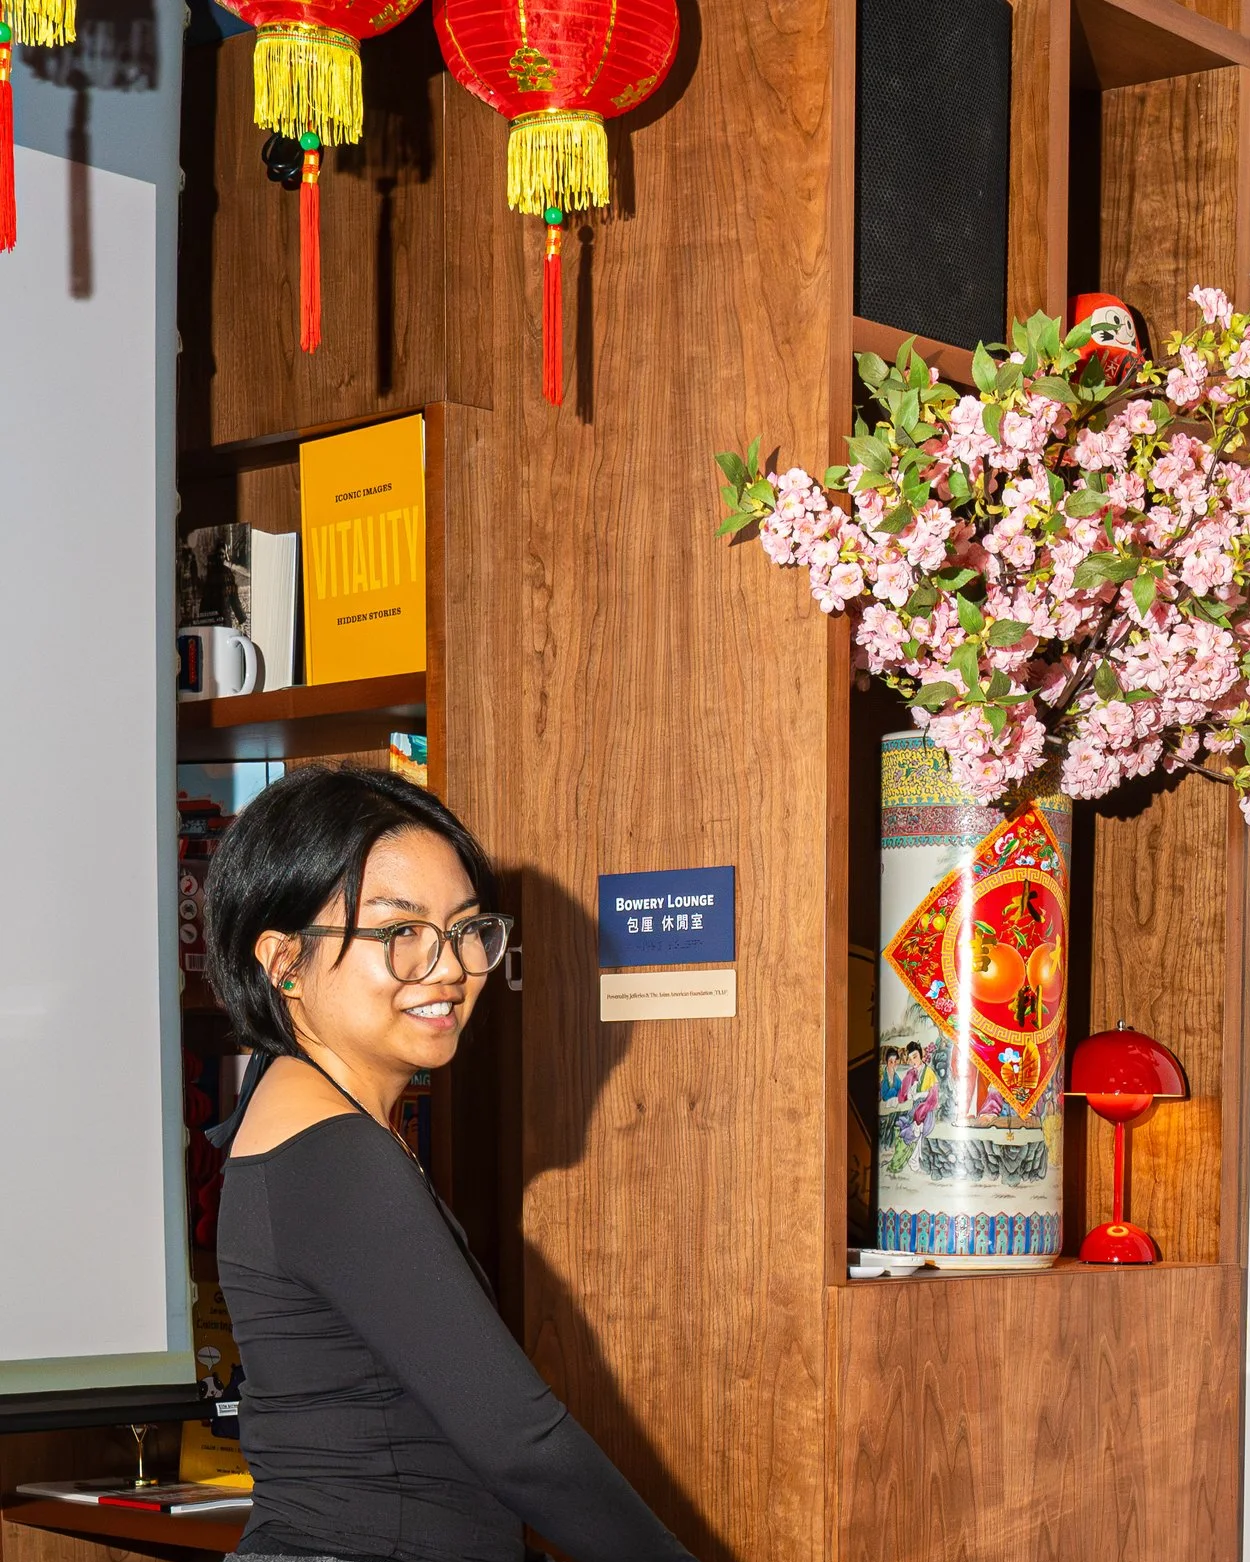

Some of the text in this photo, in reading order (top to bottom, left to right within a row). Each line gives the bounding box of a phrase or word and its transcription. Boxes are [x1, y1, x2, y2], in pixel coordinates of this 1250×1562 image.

[334, 482, 393, 503] ICONIC IMAGES
[310, 505, 419, 600] VITALITY
[336, 606, 402, 626] HIDDEN STORIES
[615, 894, 715, 912] BOWERY LOUNGE
[626, 916, 654, 934] 包厘
